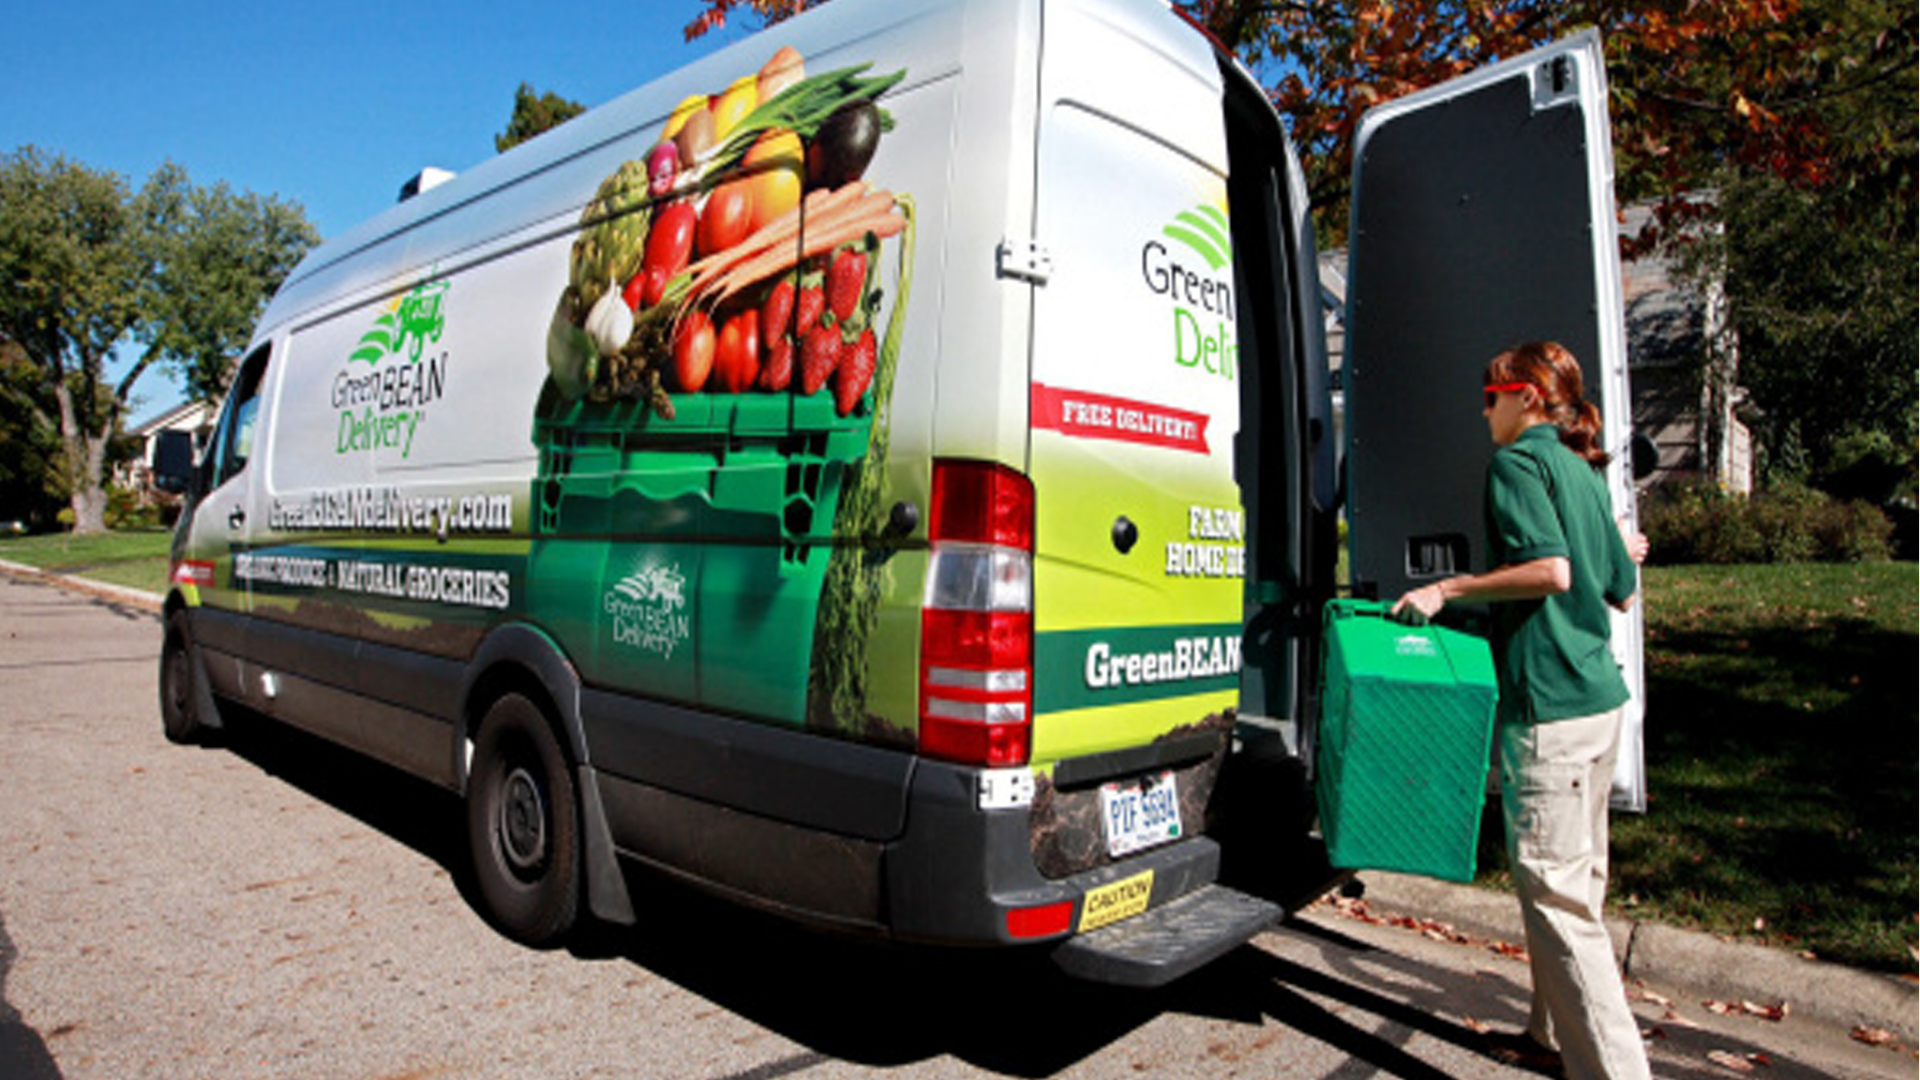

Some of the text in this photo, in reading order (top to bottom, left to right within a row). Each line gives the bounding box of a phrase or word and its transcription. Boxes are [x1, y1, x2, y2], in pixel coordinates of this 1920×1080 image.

[336, 404, 421, 459] Delivery
[1062, 400, 1112, 427] FREE
[1166, 543, 1225, 576] HOME
[338, 560, 404, 597] NATURAL
[406, 565, 509, 608] GROCERIES
[1086, 636, 1241, 688] GreenBEAN
[1088, 880, 1149, 914] CAUTION
